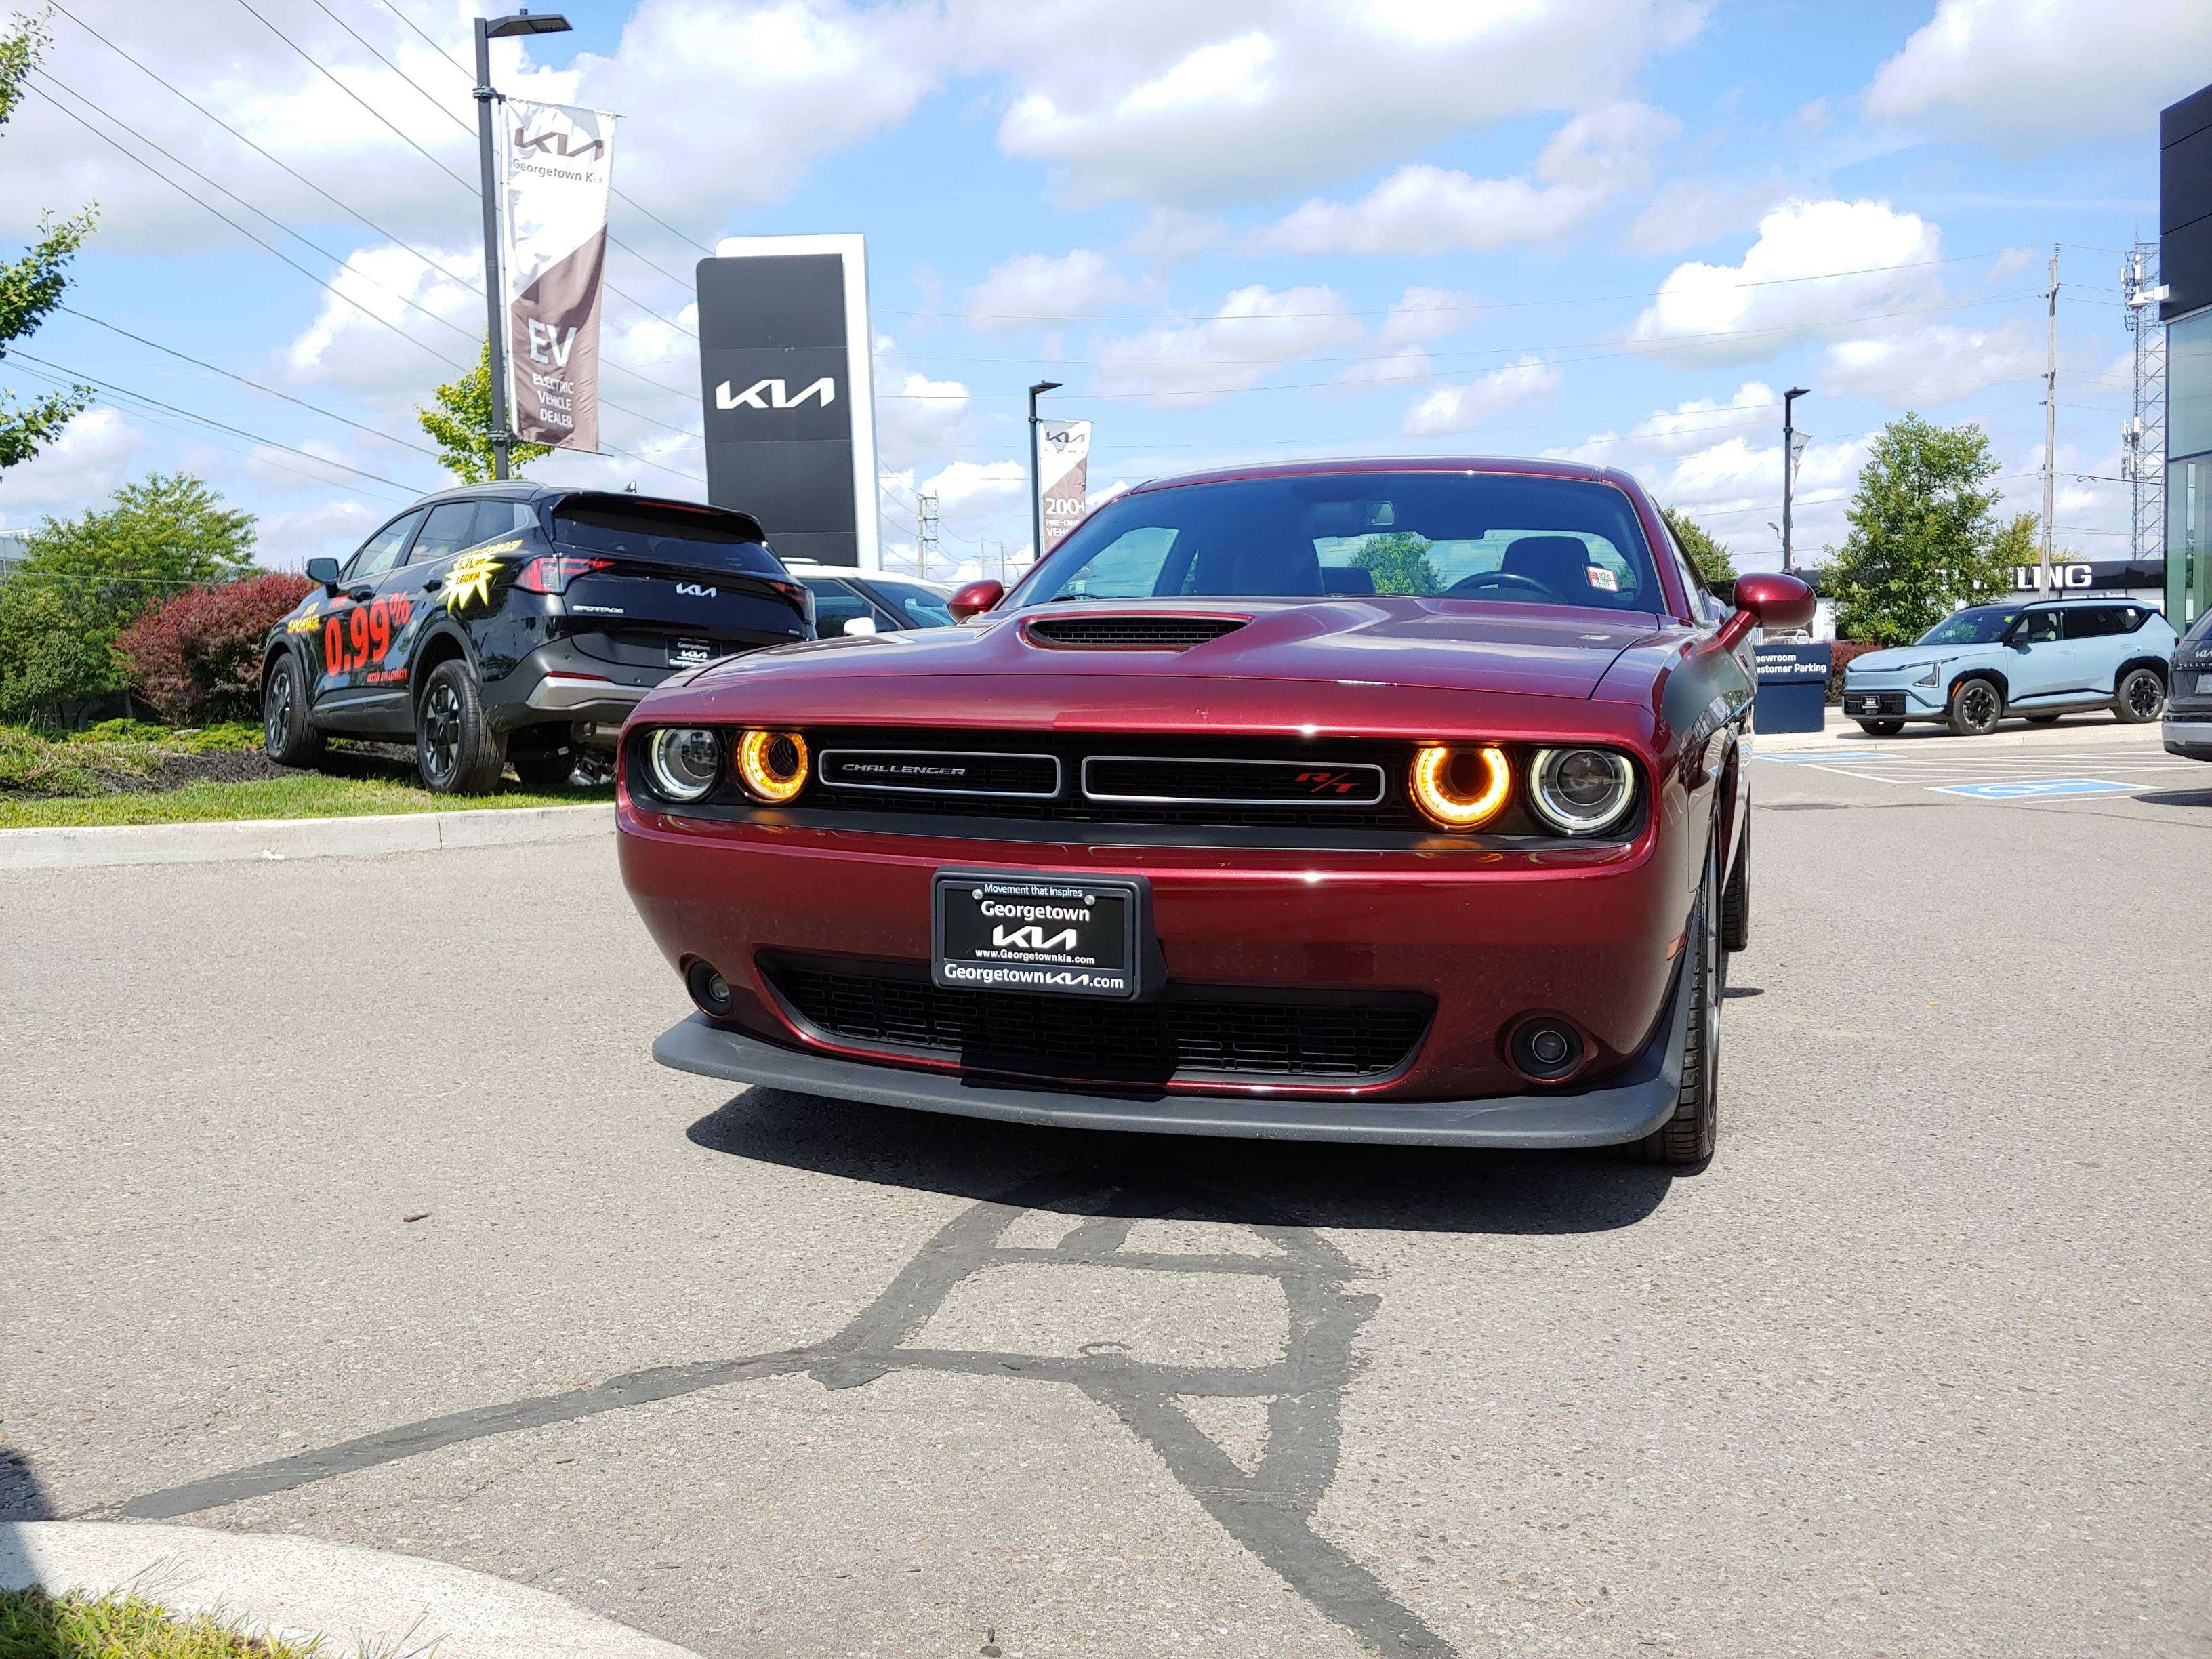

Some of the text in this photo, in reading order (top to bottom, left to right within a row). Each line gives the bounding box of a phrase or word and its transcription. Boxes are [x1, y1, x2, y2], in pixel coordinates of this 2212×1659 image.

[514, 126, 605, 161] KIA
[513, 159, 581, 181] Georgetown
[528, 317, 577, 367] EV
[532, 373, 574, 394] ELECTRIC
[716, 377, 835, 409] KIA
[537, 390, 572, 411] VEHICLE
[540, 408, 573, 428] DEALER
[1046, 497, 1085, 515] 200+
[572, 605, 624, 614] SPORTAGE
[287, 615, 320, 635] SPORTAGE
[1794, 663, 1827, 674] Parking
[842, 764, 966, 775] CHALLENGER
[1294, 772, 1361, 792] R/T
[984, 883, 1029, 895] Movement
[1030, 886, 1048, 895] that
[981, 900, 1090, 922] Georgetown
[992, 924, 1077, 951] KIA
[975, 949, 1095, 964] www.Georgetownkia.com
